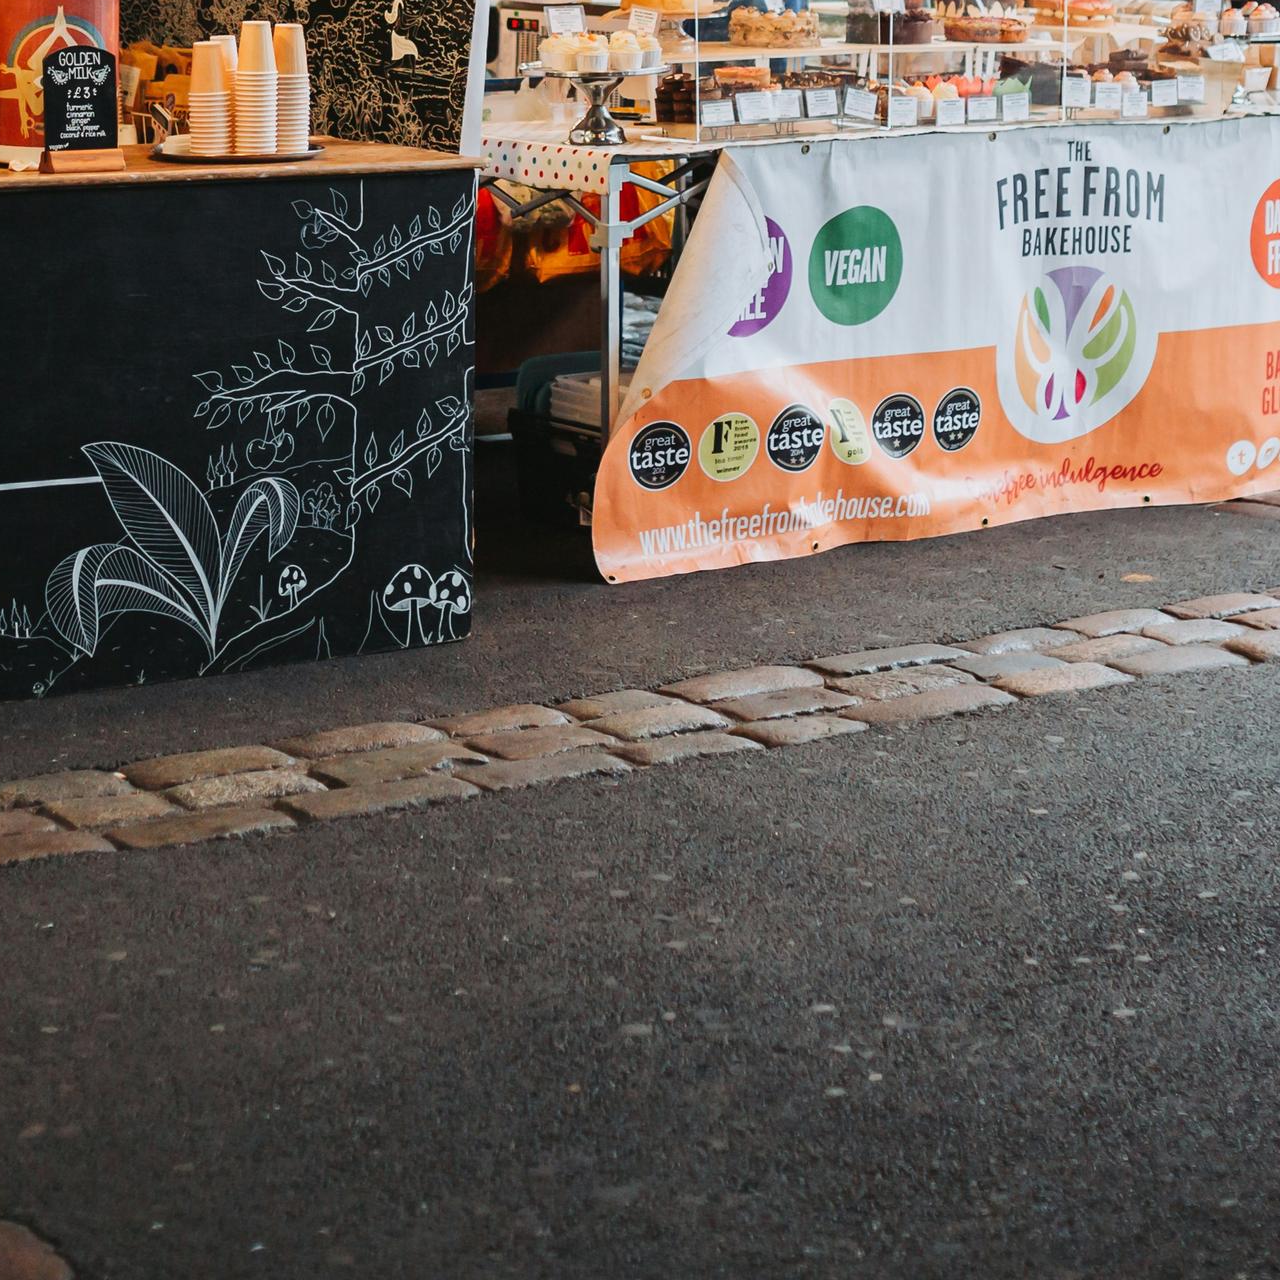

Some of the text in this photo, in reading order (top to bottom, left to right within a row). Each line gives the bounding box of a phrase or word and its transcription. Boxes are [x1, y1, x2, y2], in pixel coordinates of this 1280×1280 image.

[59, 51, 100, 66] GOLDEN
[68, 66, 93, 79] MILK
[73, 86, 90, 99] £3
[71, 118, 91, 126] ginger
[1068, 140, 1092, 162] THE
[996, 166, 1165, 230] FREE FROM
[1022, 225, 1132, 257] BAKEHOUSE
[824, 245, 887, 286] VEGAN
[884, 406, 911, 422] great
[945, 400, 971, 416] great
[782, 415, 812, 432] great
[874, 419, 923, 439] taste
[935, 411, 979, 433] taste
[644, 434, 676, 451] great
[712, 420, 732, 454] F
[769, 428, 824, 451] taste
[631, 447, 689, 470] taste
[716, 466, 740, 474] winner
[1040, 456, 1164, 493] indulgence
